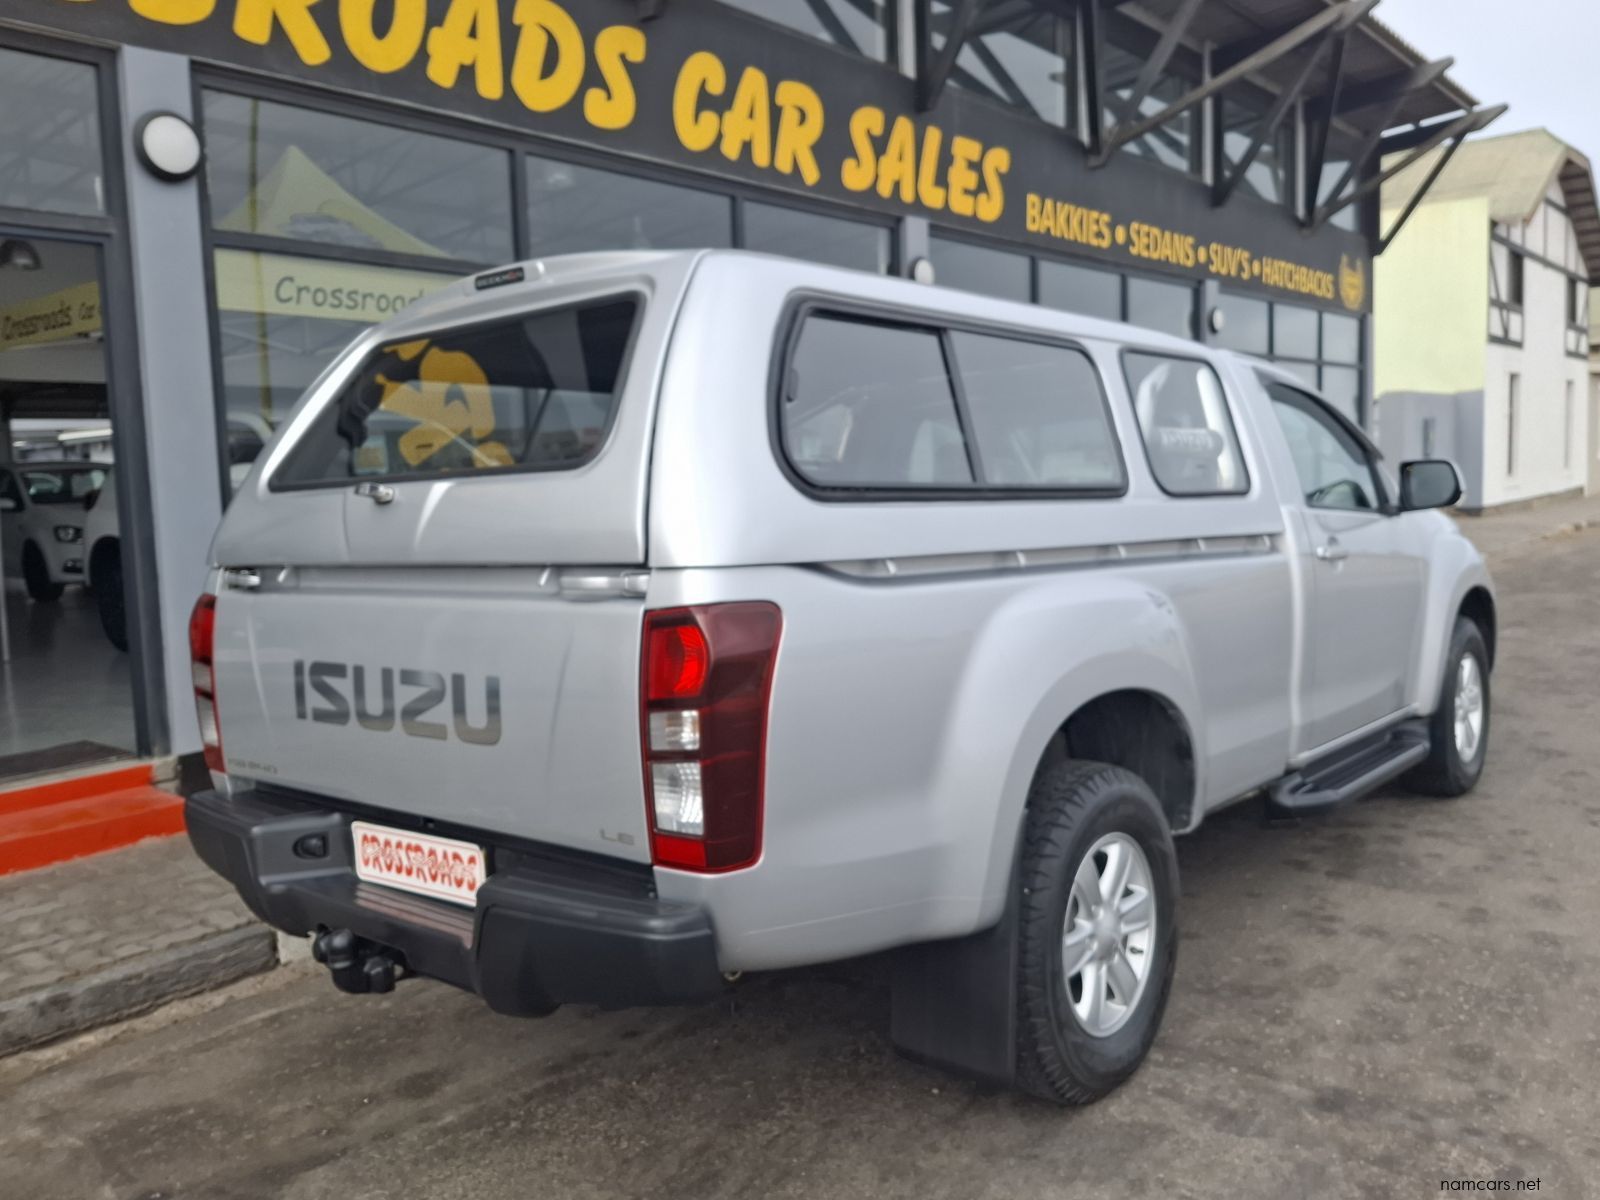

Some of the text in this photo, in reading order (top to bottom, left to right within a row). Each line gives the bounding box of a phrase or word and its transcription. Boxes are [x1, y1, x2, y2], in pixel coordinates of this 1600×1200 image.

[672, 51, 825, 187] CAR
[840, 106, 1011, 223] SALES
[1025, 192, 1335, 300] BAKKIES SEDANS SUV'S HATCHBACKS
[294, 658, 502, 746] ISUZU
[361, 833, 477, 892] CROSSROADS
